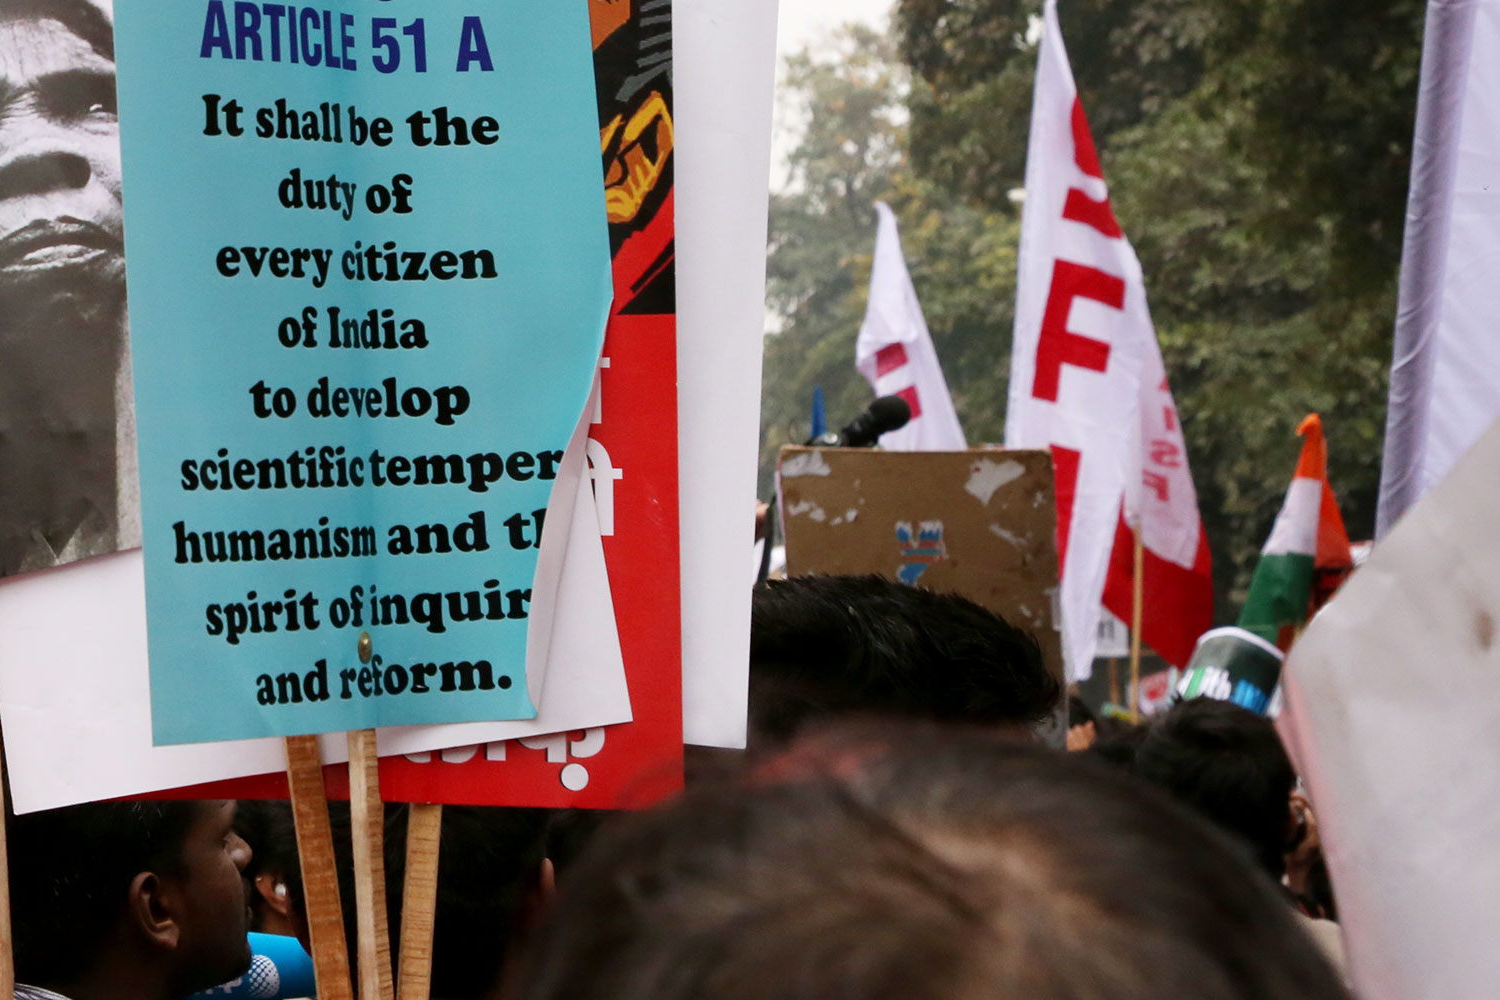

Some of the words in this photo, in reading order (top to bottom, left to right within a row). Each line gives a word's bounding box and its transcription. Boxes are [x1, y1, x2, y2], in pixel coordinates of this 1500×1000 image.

[200, 0, 357, 71] ARTICLE
[371, 17, 427, 74] 51
[456, 16, 494, 72] A
[201, 93, 245, 137] It
[255, 97, 344, 144] shall
[347, 105, 394, 147] be
[405, 106, 500, 147] the
[277, 167, 357, 222] duty
[365, 173, 414, 215] of
[215, 246, 334, 289] every
[341, 240, 499, 282] citizen
[277, 305, 318, 349] of
[326, 306, 430, 350] India
[248, 379, 297, 419] to
[306, 376, 471, 426] develop
[180, 445, 365, 491] scientific
[367, 447, 565, 494] temper
[172, 516, 378, 564] humanism
[387, 510, 491, 556] and
[205, 587, 321, 646] spirit
[328, 584, 365, 629] of
[255, 658, 331, 706] and
[337, 652, 513, 701] reform.
